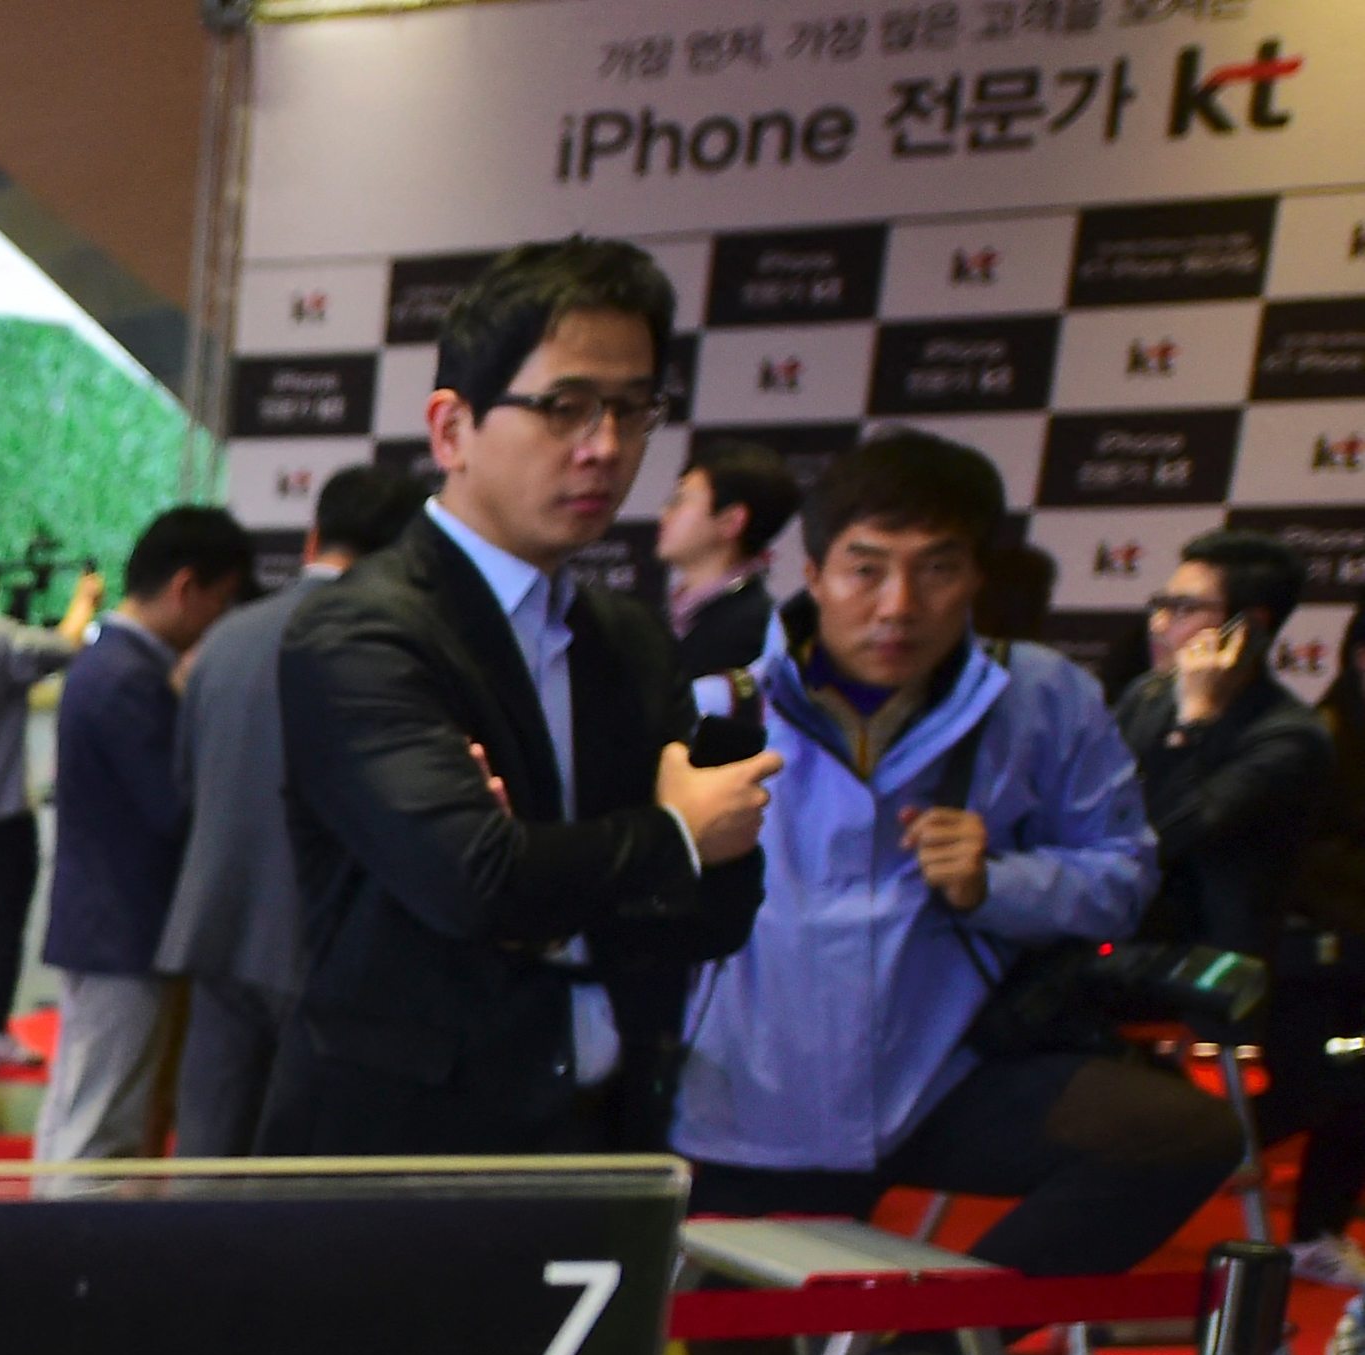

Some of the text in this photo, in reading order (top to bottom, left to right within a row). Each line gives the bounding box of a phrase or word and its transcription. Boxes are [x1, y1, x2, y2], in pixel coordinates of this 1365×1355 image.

[597, 36, 674, 81] 가장
[786, 17, 867, 62] 가장
[556, 37, 1303, 182] iPhone 전문가 kt
[949, 246, 998, 288] kt
[290, 289, 327, 323] kt
[758, 354, 802, 393] kt
[1125, 337, 1180, 378] kt
[1311, 432, 1365, 474] kt
[1093, 539, 1141, 580] kt
[1275, 635, 1328, 674] kt
